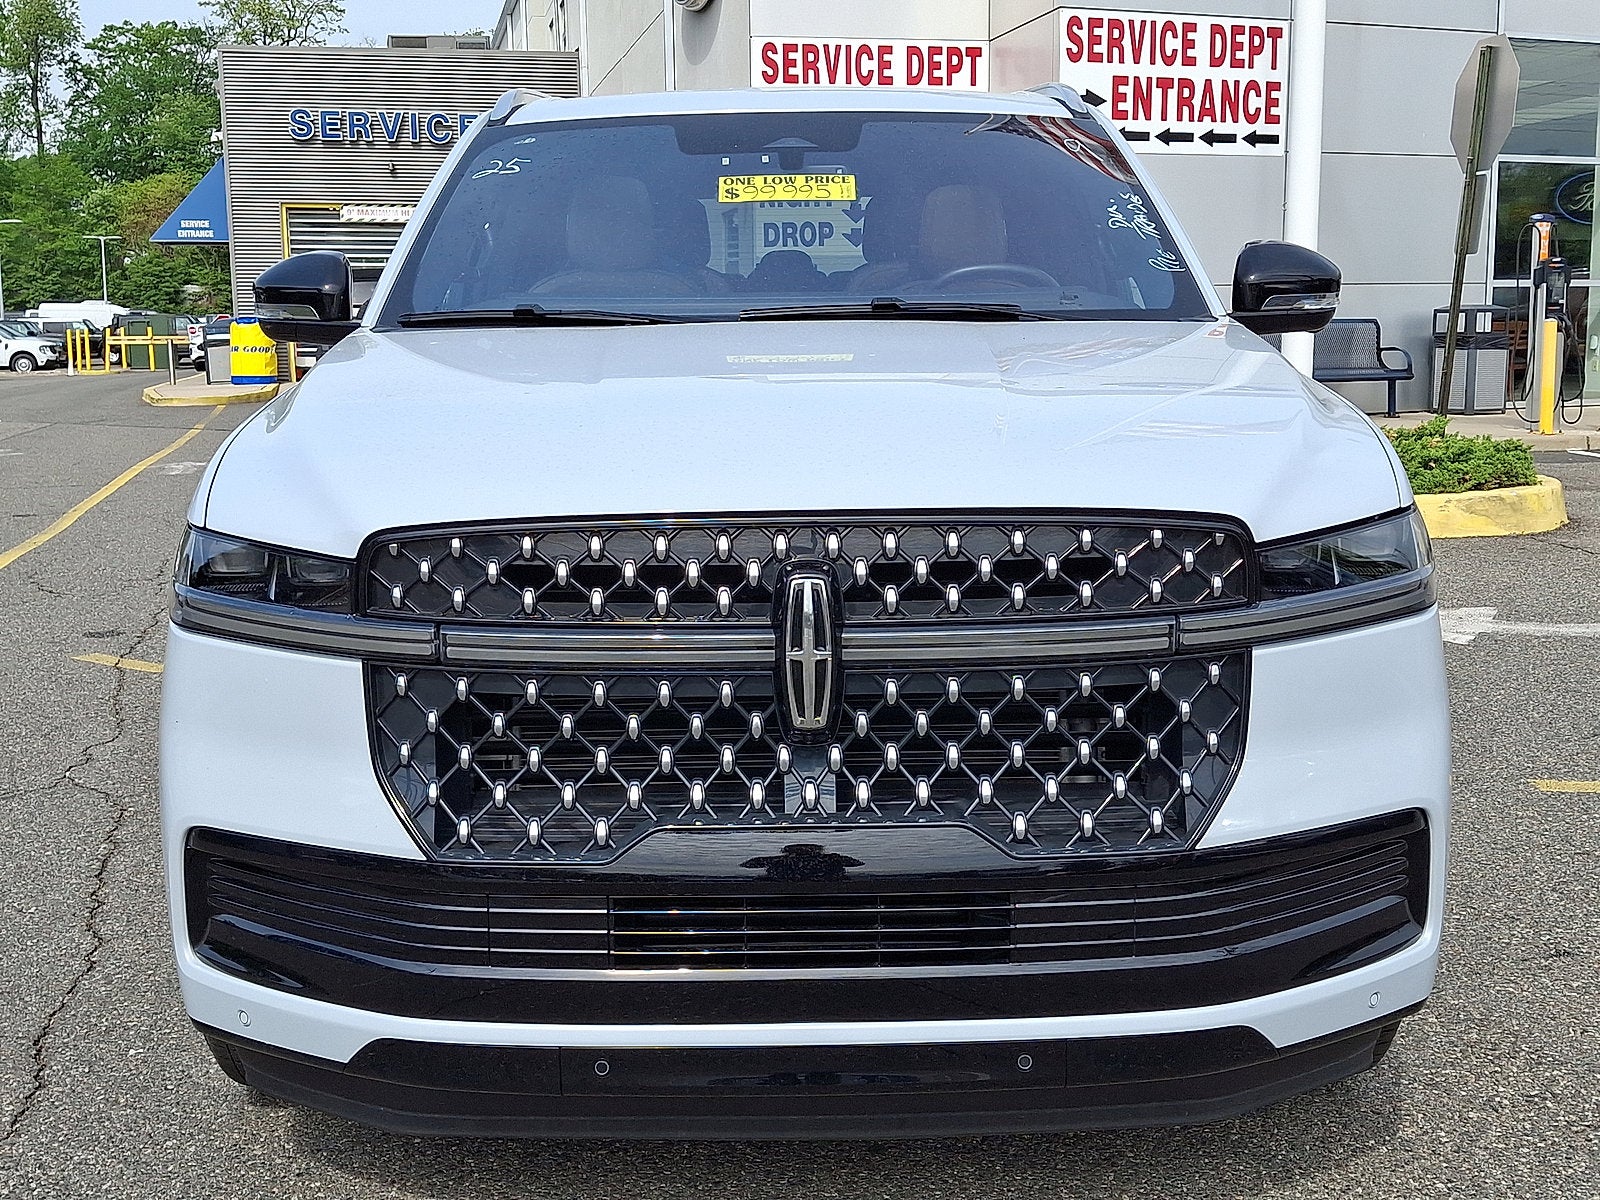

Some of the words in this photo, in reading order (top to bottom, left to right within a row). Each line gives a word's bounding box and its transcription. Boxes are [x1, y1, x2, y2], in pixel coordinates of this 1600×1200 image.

[1066, 15, 1197, 66] SERVICE
[1209, 24, 1283, 70] DEPT
[761, 41, 894, 86] SERVICE
[906, 46, 982, 86] DEPT
[1112, 75, 1281, 124] ENTRANCE
[472, 157, 532, 179] 25
[723, 177, 755, 186] ONE
[763, 176, 797, 185] LOW
[804, 175, 851, 184] PRICE
[177, 229, 214, 238] ENTRANCE
[180, 219, 210, 228] SERVICE
[763, 220, 834, 248] DROP
